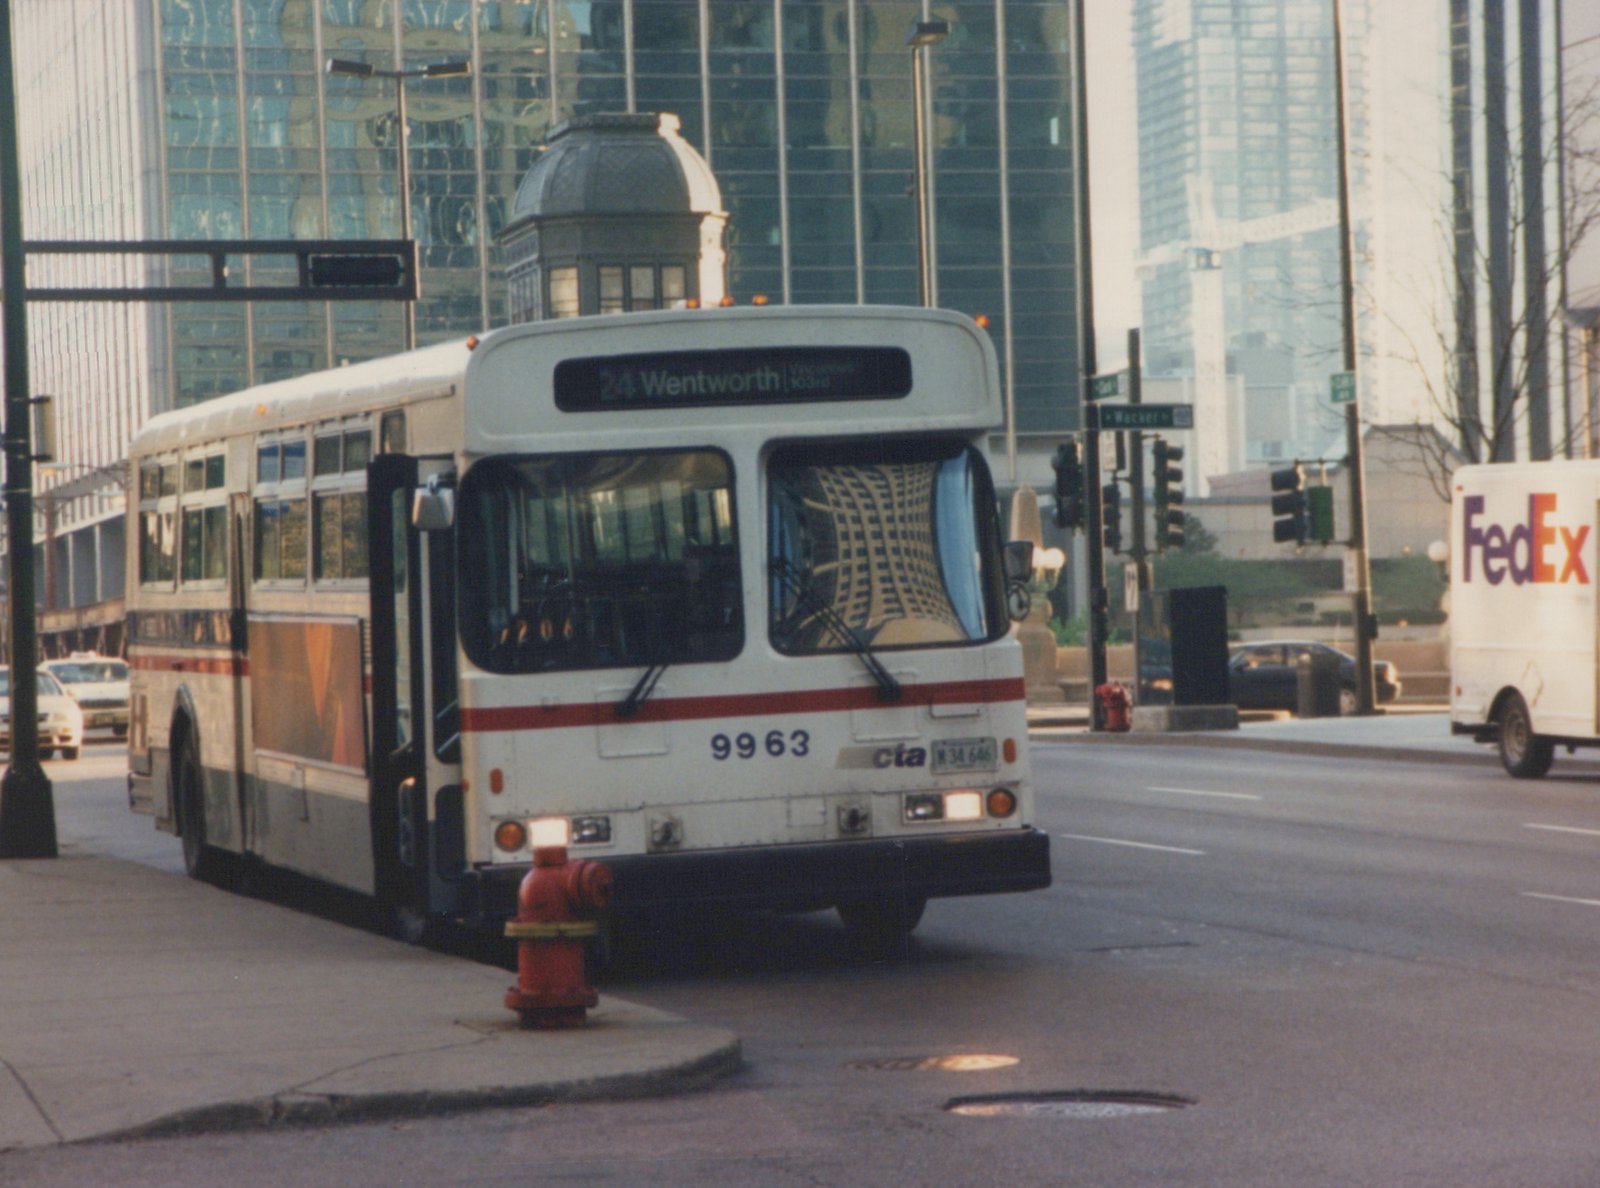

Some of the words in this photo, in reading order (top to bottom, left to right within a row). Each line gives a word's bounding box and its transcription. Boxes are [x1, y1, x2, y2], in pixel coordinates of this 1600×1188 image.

[600, 368, 636, 399] 24
[641, 366, 780, 396] Wentworth
[1463, 492, 1591, 587] FedEx
[710, 729, 810, 760] 9963
[872, 743, 927, 768] cta
